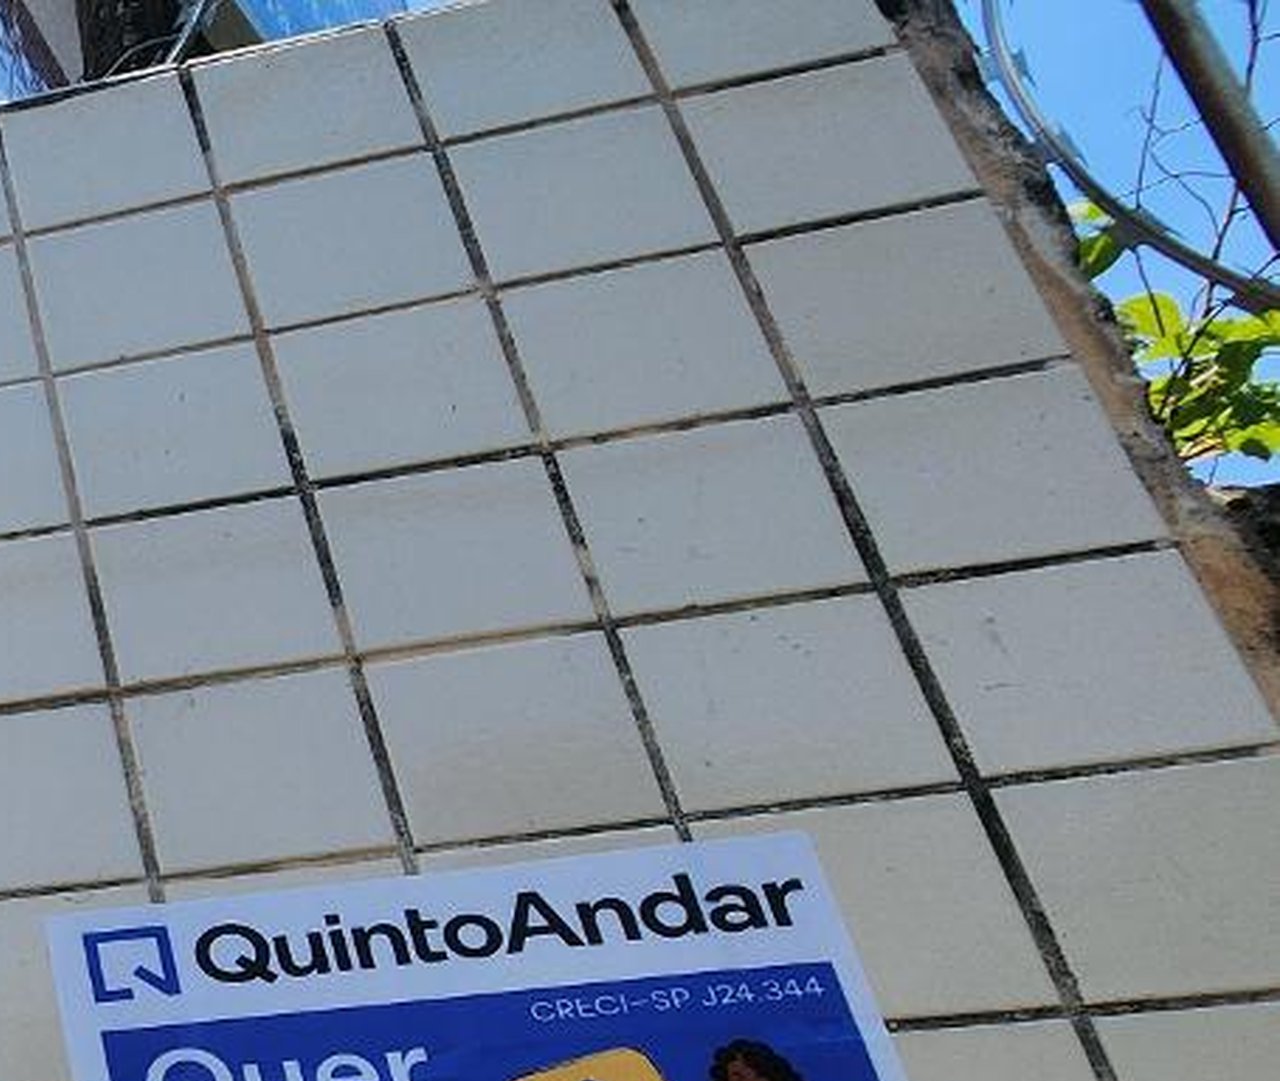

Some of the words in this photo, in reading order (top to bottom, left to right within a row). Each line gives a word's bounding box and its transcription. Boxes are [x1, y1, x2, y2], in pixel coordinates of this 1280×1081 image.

[194, 872, 804, 984] QuintoAndar
[530, 987, 690, 1023] CRECI-SP
[701, 976, 826, 1008] J24.344
